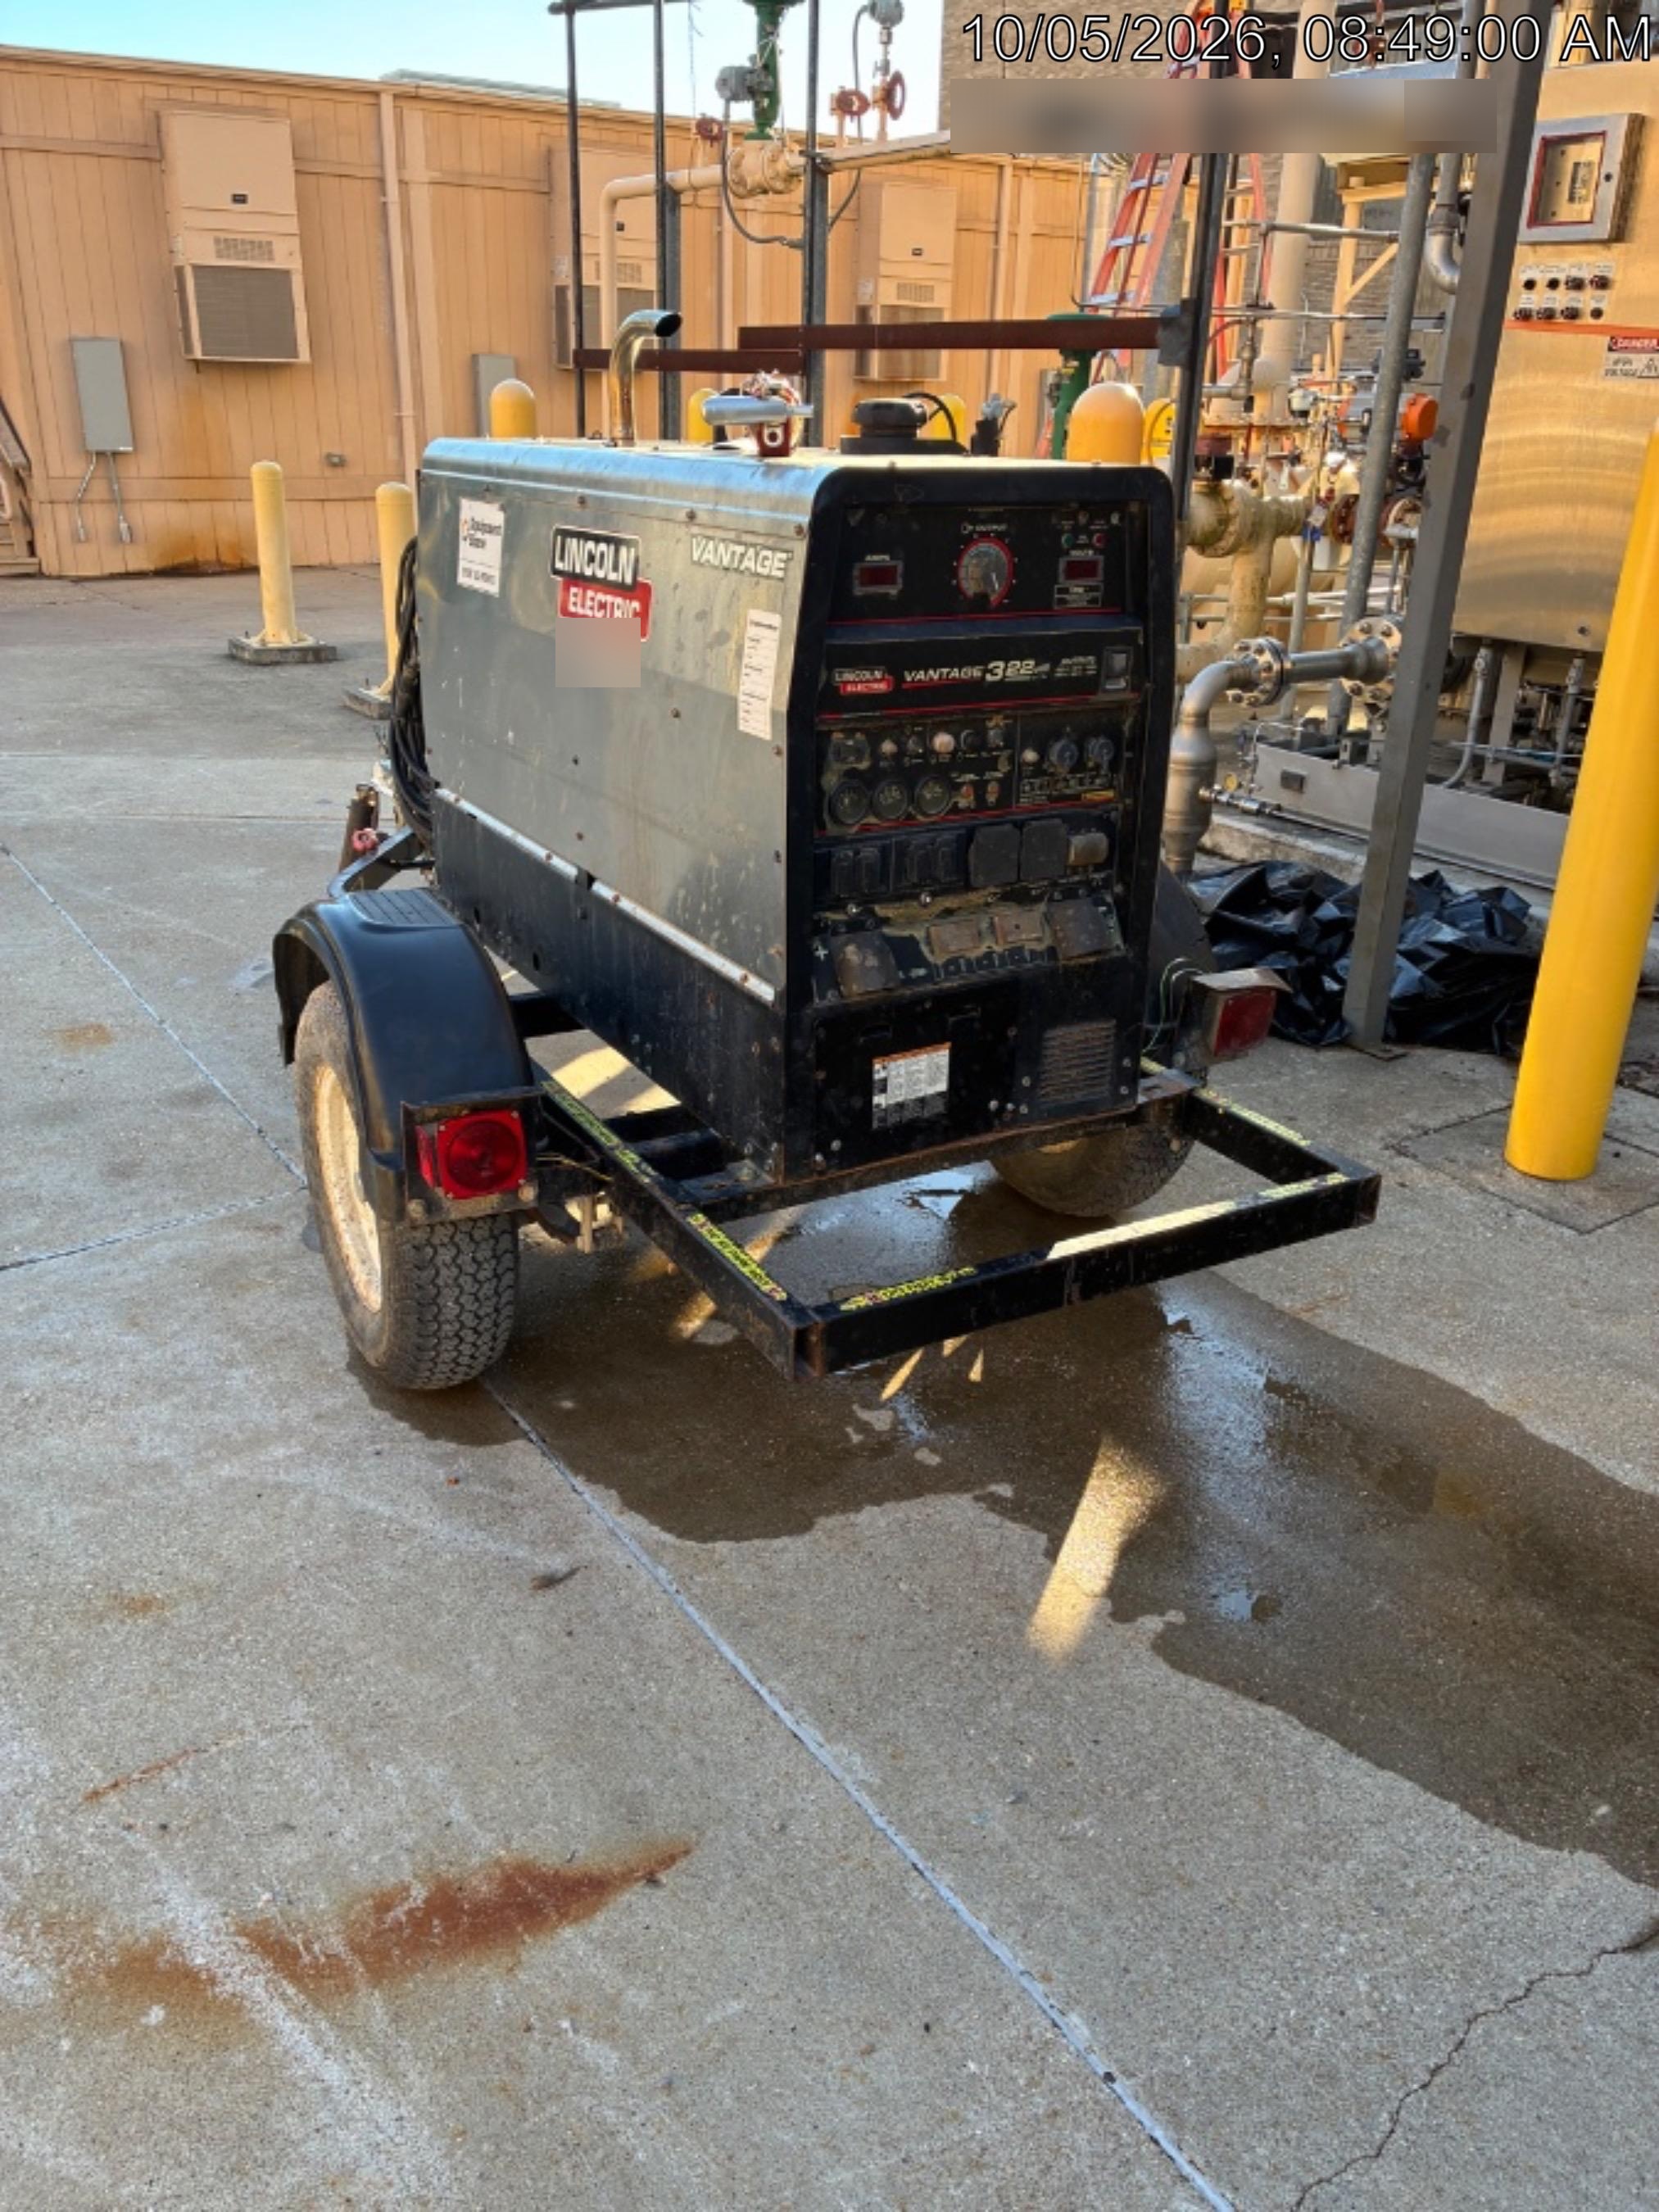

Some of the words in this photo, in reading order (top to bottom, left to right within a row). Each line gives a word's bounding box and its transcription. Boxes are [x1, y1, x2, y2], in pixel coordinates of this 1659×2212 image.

[554, 534, 635, 586] LINCOLN
[691, 536, 788, 578] VANTAGE
[567, 586, 641, 619] ELECTRIC
[834, 669, 884, 682] LINCOLN
[903, 665, 986, 682] VANTAGE
